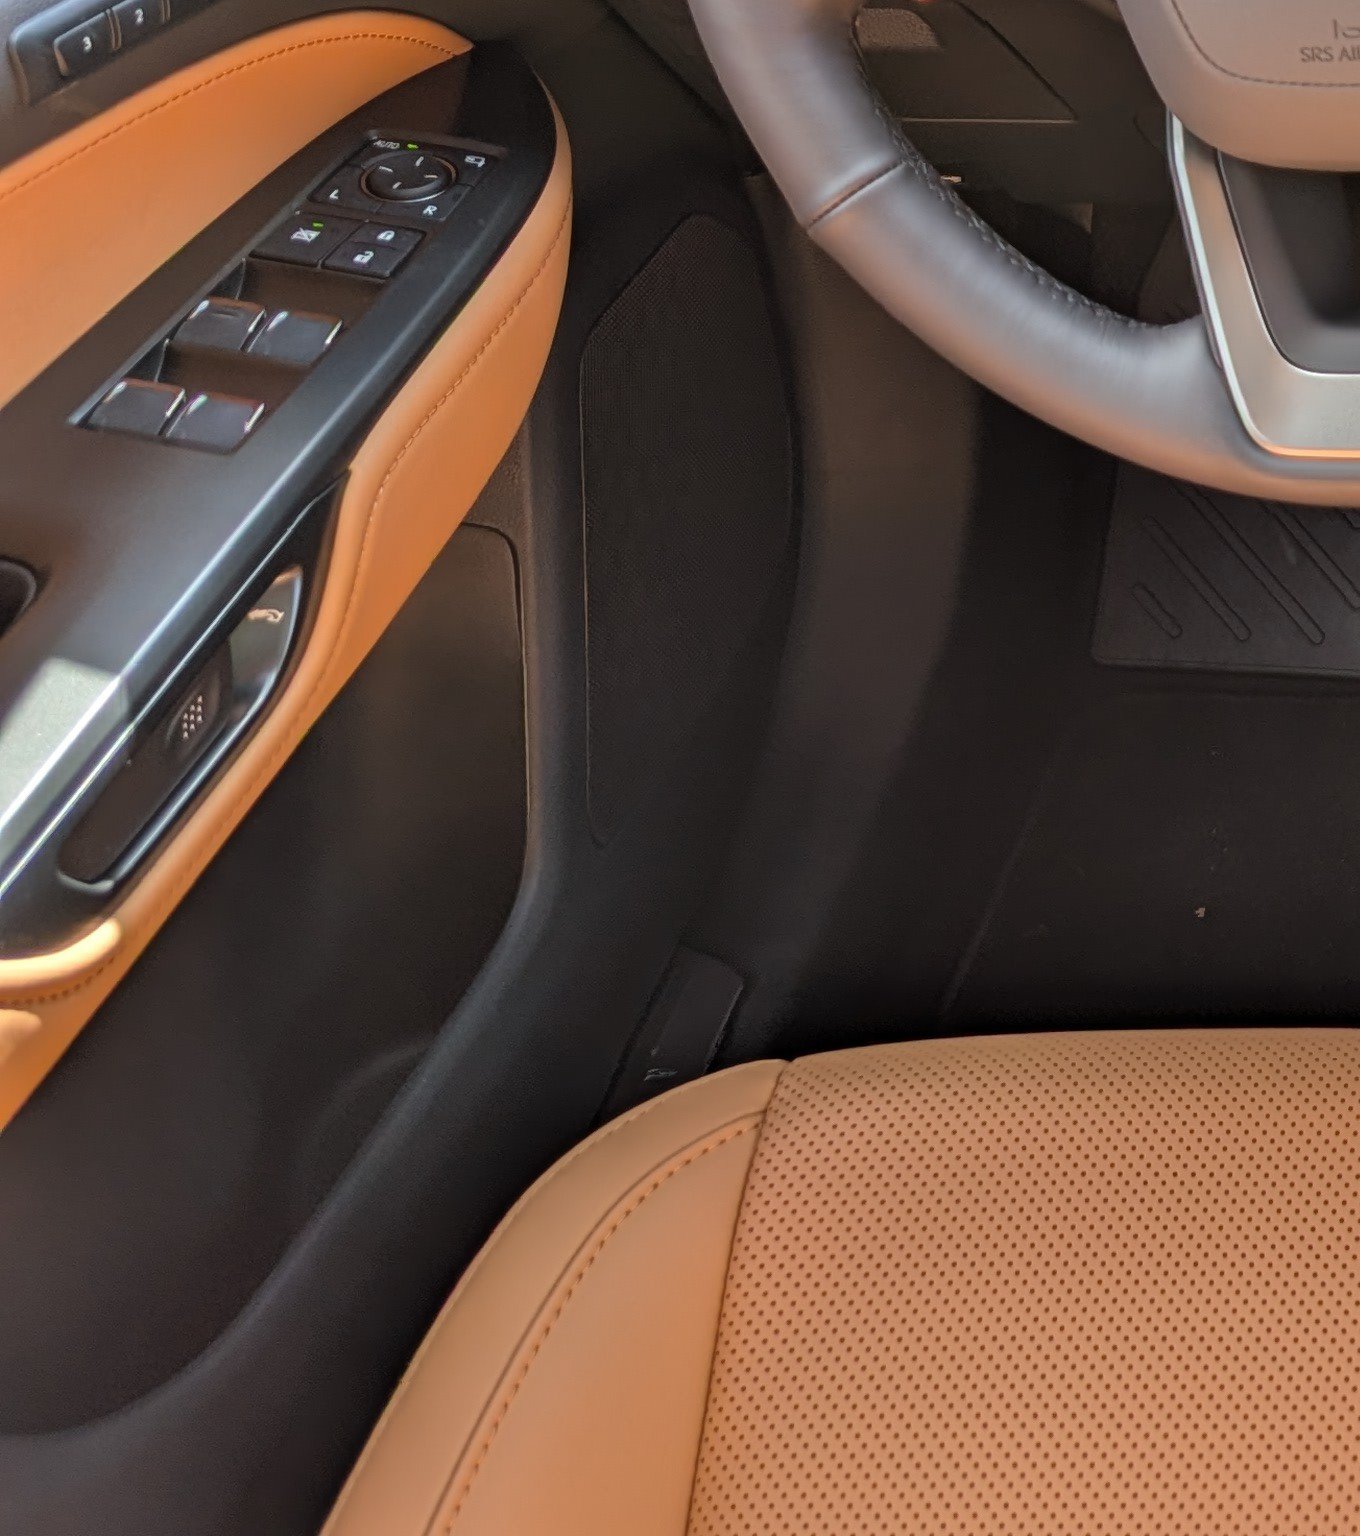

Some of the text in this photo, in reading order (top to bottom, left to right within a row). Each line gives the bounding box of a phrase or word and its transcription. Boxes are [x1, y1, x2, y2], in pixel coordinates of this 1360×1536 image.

[134, 8, 144, 25] 2
[82, 36, 92, 53] 3
[1300, 46, 1334, 63] SRS
[374, 140, 401, 150] AUTO
[329, 189, 339, 200] L
[422, 205, 437, 215] R
